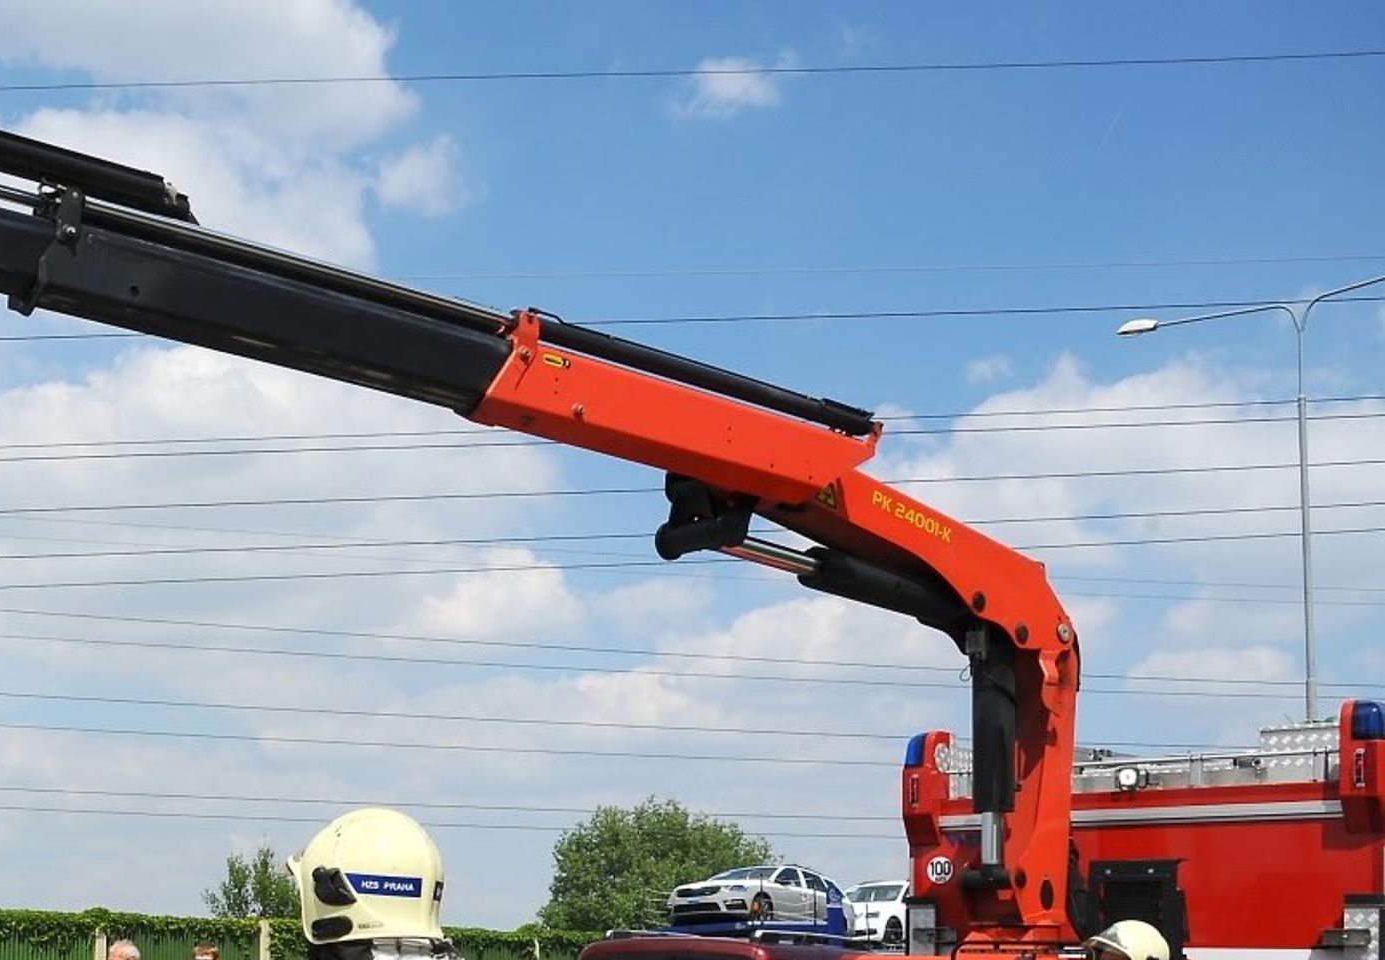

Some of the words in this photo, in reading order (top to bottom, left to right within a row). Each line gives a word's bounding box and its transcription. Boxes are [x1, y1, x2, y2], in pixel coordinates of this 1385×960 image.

[872, 490, 892, 512] PK
[895, 502, 951, 543] 24001-K
[930, 860, 951, 876] 100
[361, 880, 379, 889] HZS
[383, 881, 414, 891] PRAHA
